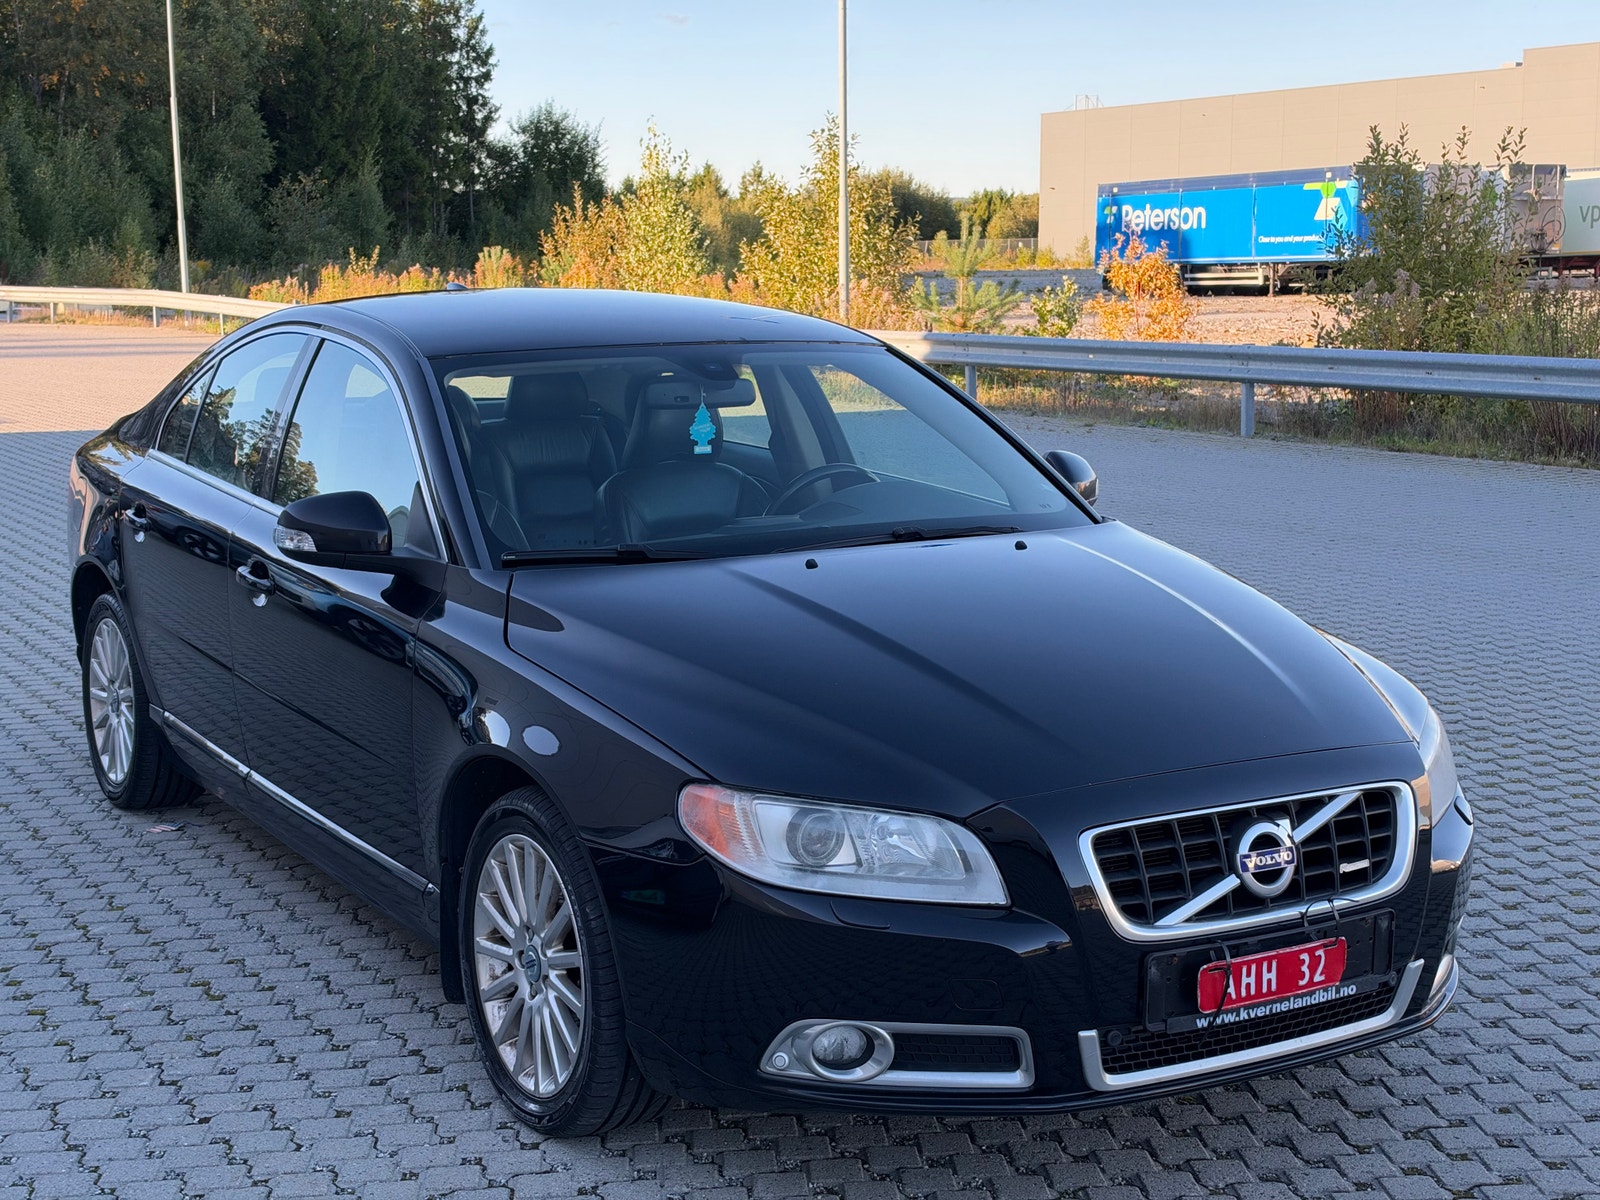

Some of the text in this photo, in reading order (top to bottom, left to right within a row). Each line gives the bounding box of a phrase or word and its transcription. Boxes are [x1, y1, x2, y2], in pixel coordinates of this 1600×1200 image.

[1121, 204, 1206, 231] Peterson
[1243, 851, 1293, 869] VOLVO
[1224, 950, 1325, 999] AHH 32
[1196, 984, 1357, 1028] www.kvernelandbil.no
